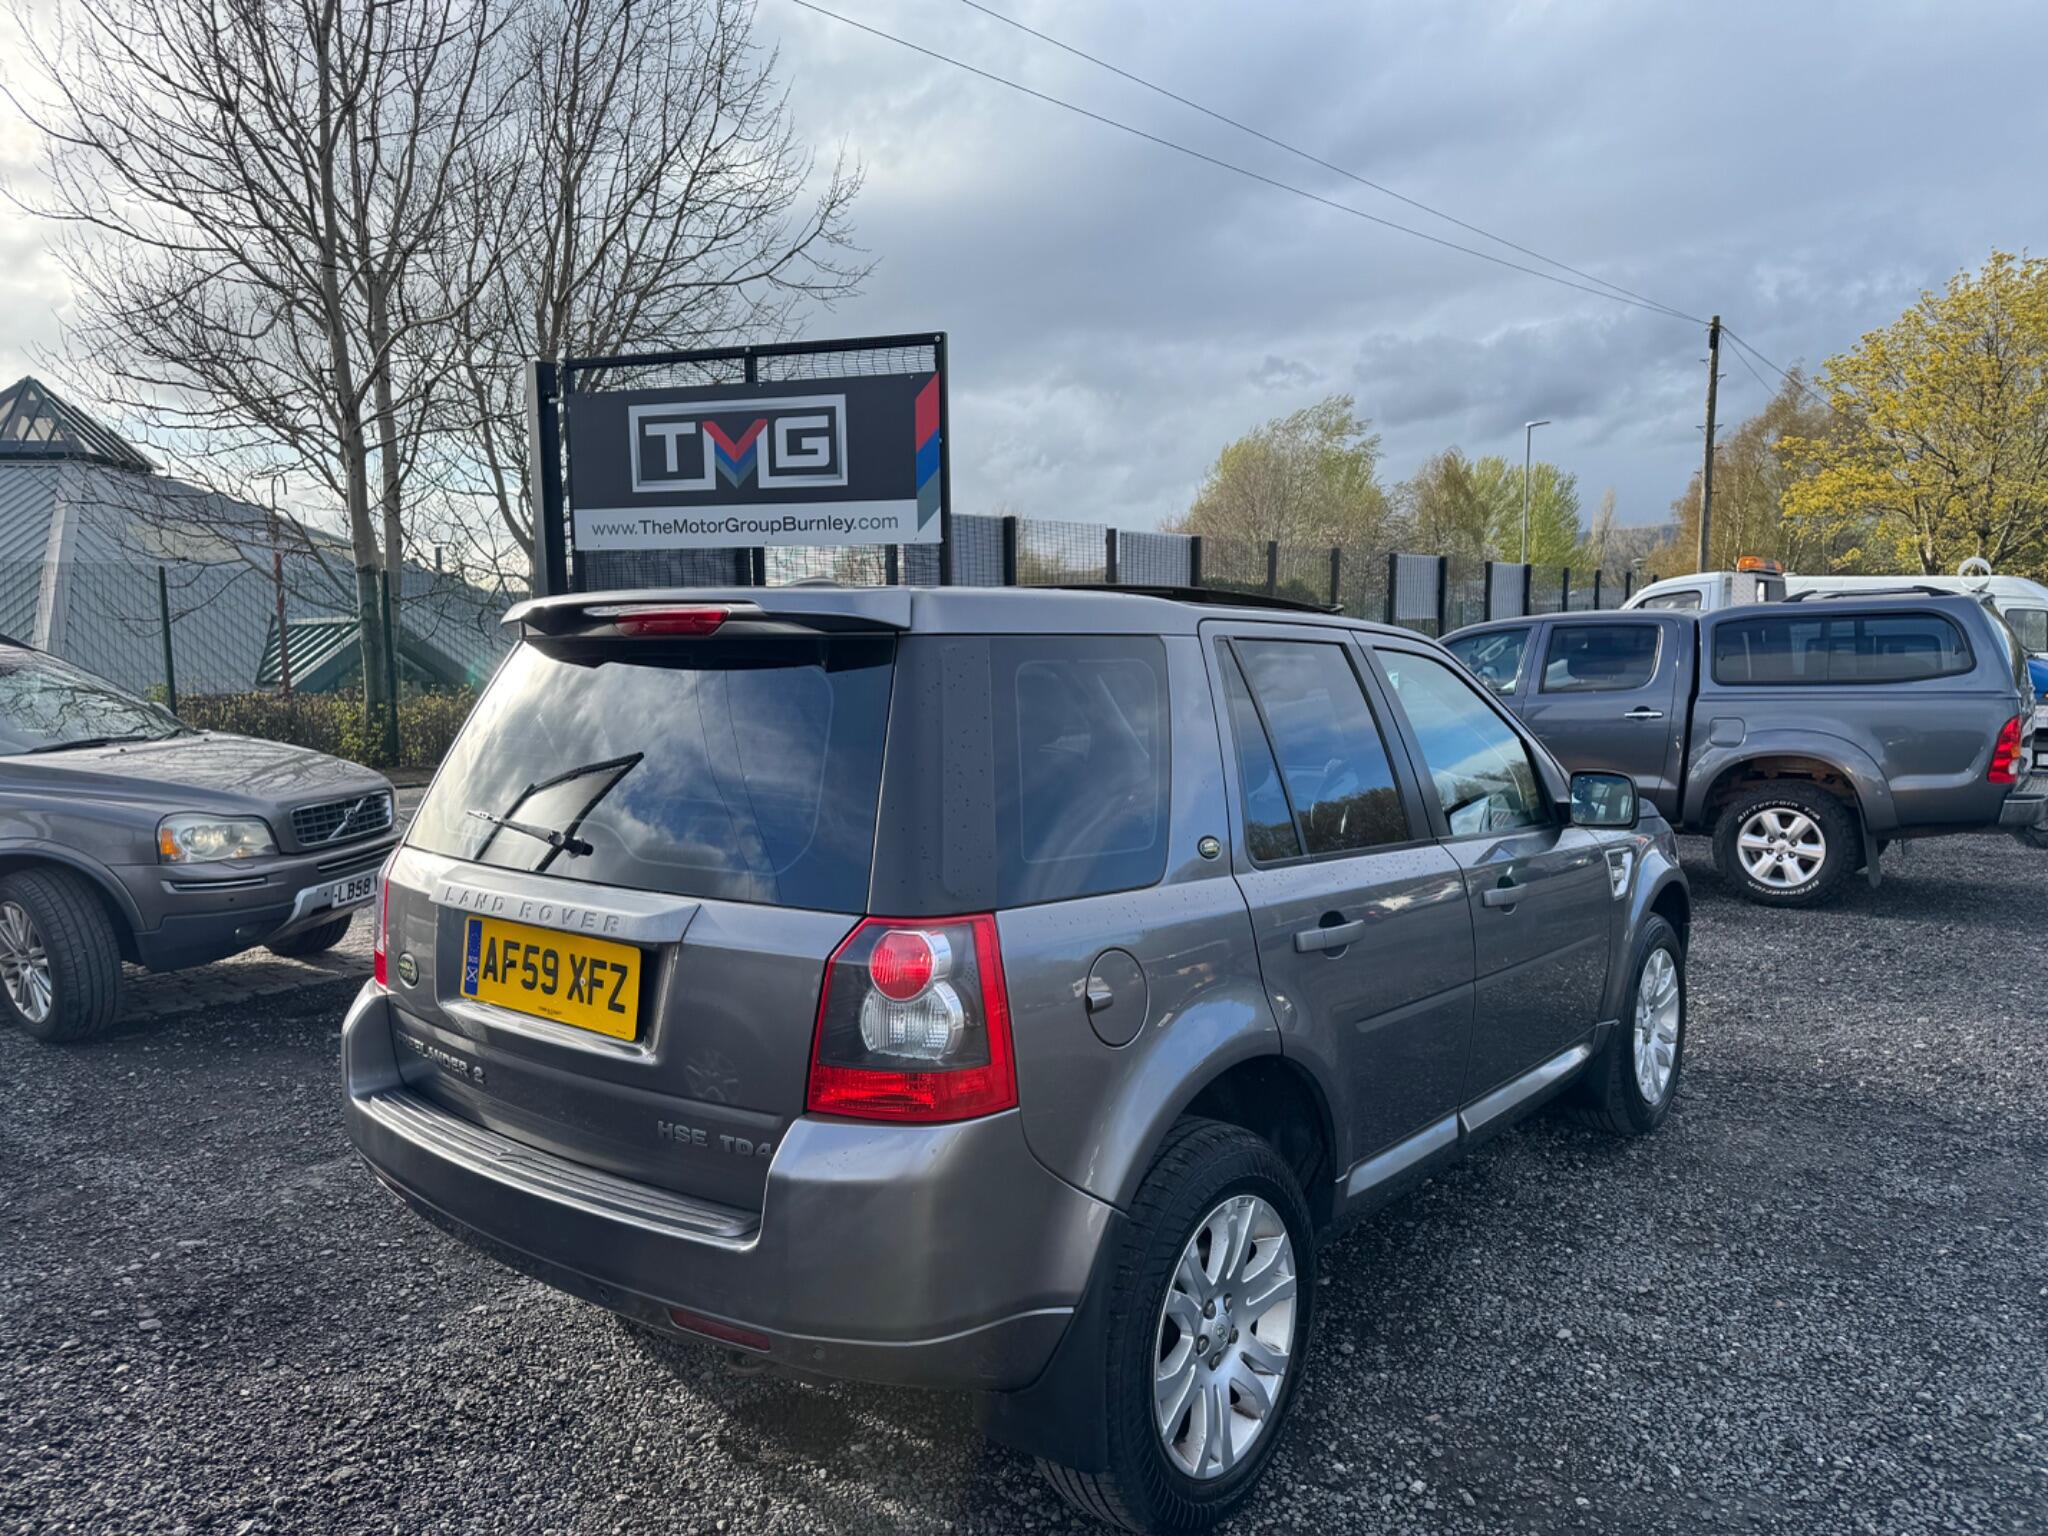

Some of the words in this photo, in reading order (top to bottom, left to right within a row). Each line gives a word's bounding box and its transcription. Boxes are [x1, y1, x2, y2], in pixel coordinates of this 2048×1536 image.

[643, 411, 833, 490] TMG
[591, 514, 899, 537] www.TheMotorGroupBurnley.com
[338, 878, 371, 903] LB58
[445, 886, 506, 913] LAND
[519, 900, 621, 932] ROVER
[482, 936, 559, 996] AF59
[566, 953, 628, 1014] XFZ
[473, 1065, 485, 1085] 2
[657, 1120, 707, 1146] HSE
[719, 1134, 774, 1157] TD4
